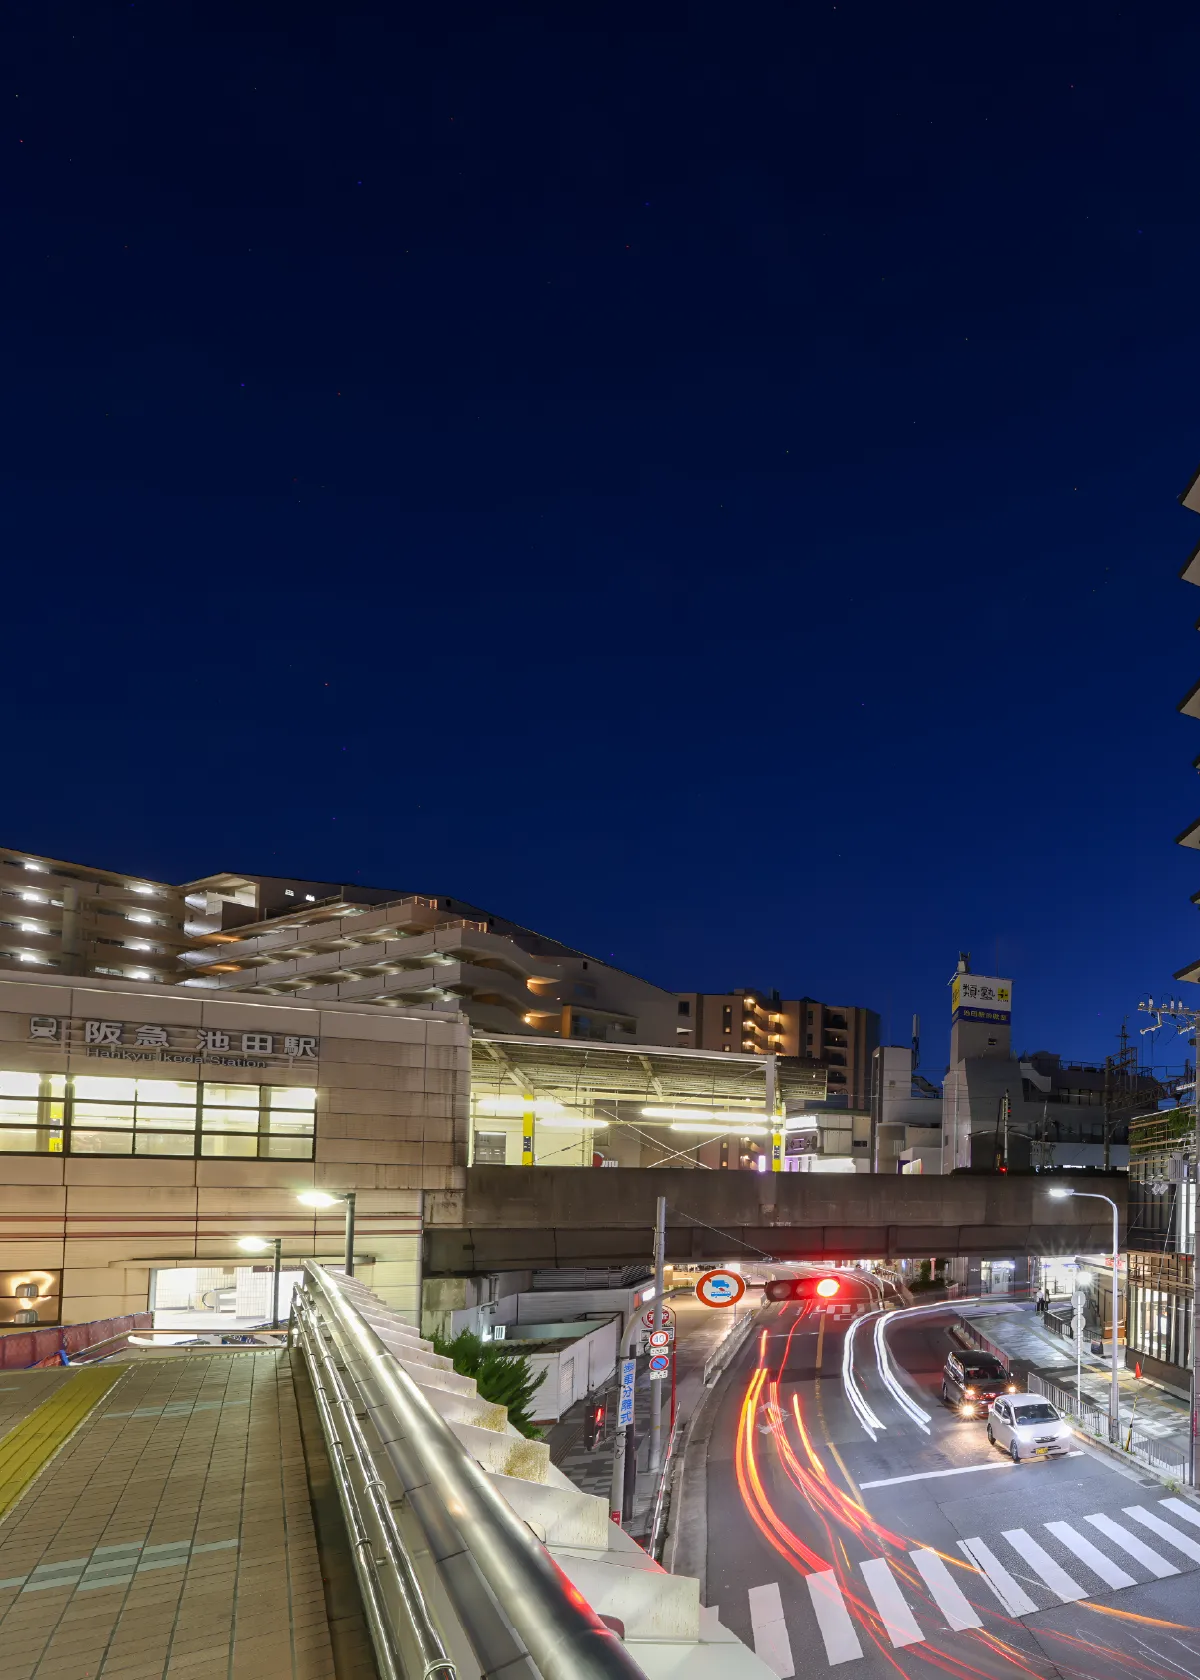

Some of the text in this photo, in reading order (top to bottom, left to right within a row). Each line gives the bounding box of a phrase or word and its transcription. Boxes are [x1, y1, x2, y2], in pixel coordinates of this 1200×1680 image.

[85, 1021, 317, 1057] 阪急 池田駅
[85, 1048, 267, 1068] Hankyu Ikeda Station
[654, 1334, 665, 1343] 40
[620, 1362, 635, 1424] 歩車分離式
